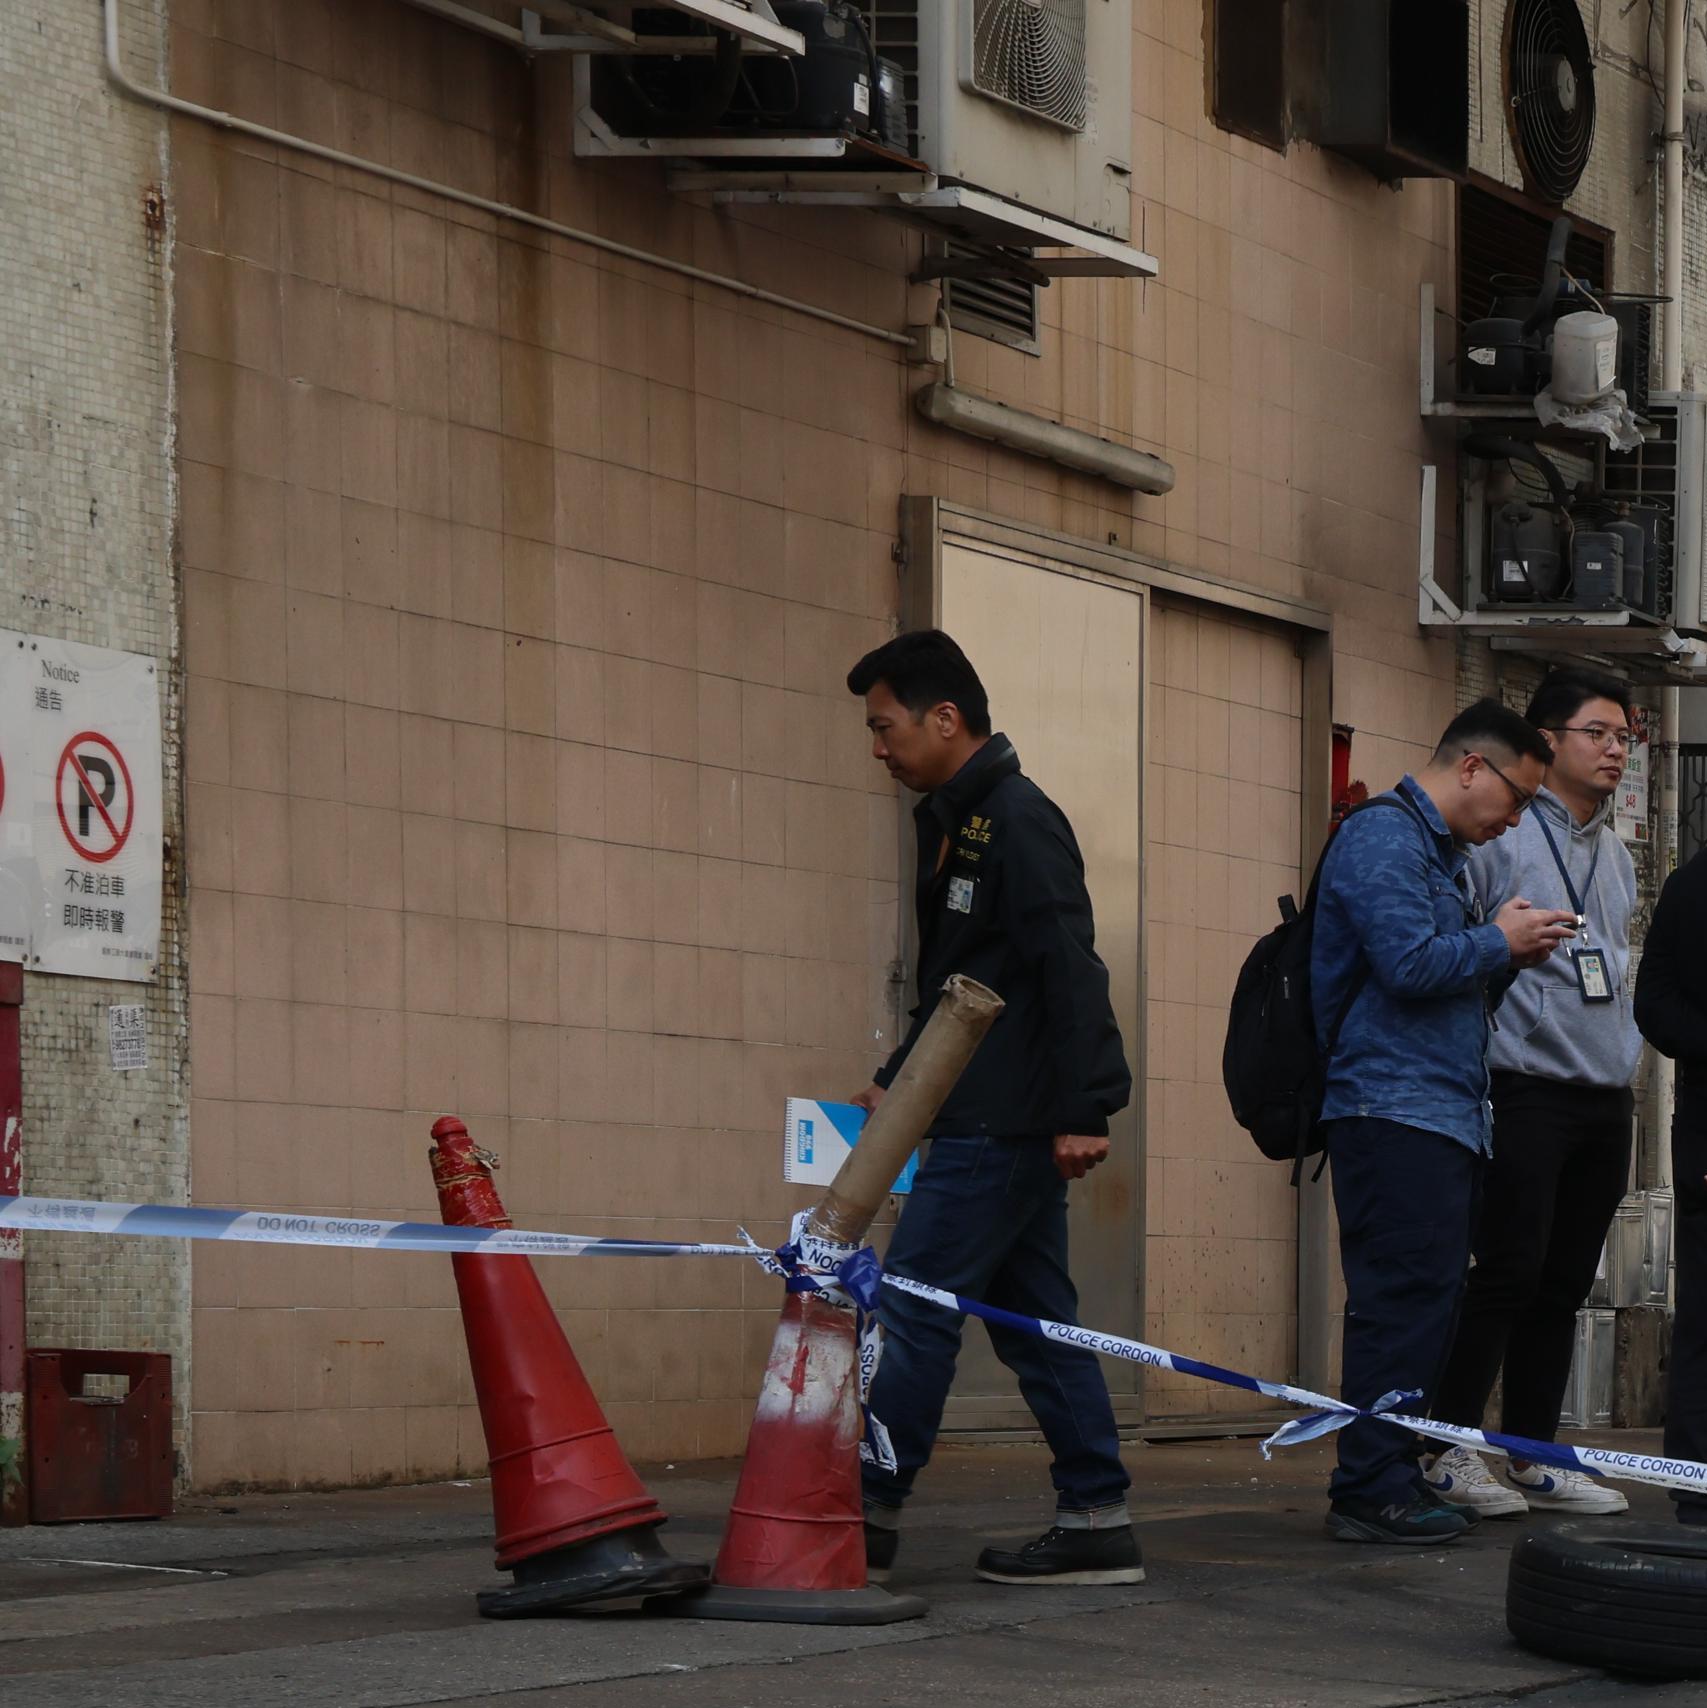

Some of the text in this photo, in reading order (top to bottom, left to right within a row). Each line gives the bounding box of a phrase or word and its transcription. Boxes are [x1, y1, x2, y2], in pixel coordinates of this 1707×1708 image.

[41, 659, 80, 684] Notice
[34, 686, 63, 712] 通告
[64, 868, 125, 897] 不准泊車
[64, 903, 125, 935] 即時報警
[1047, 1322, 1164, 1367] POLICE CORDON
[1584, 1447, 1637, 1468] POLICE
